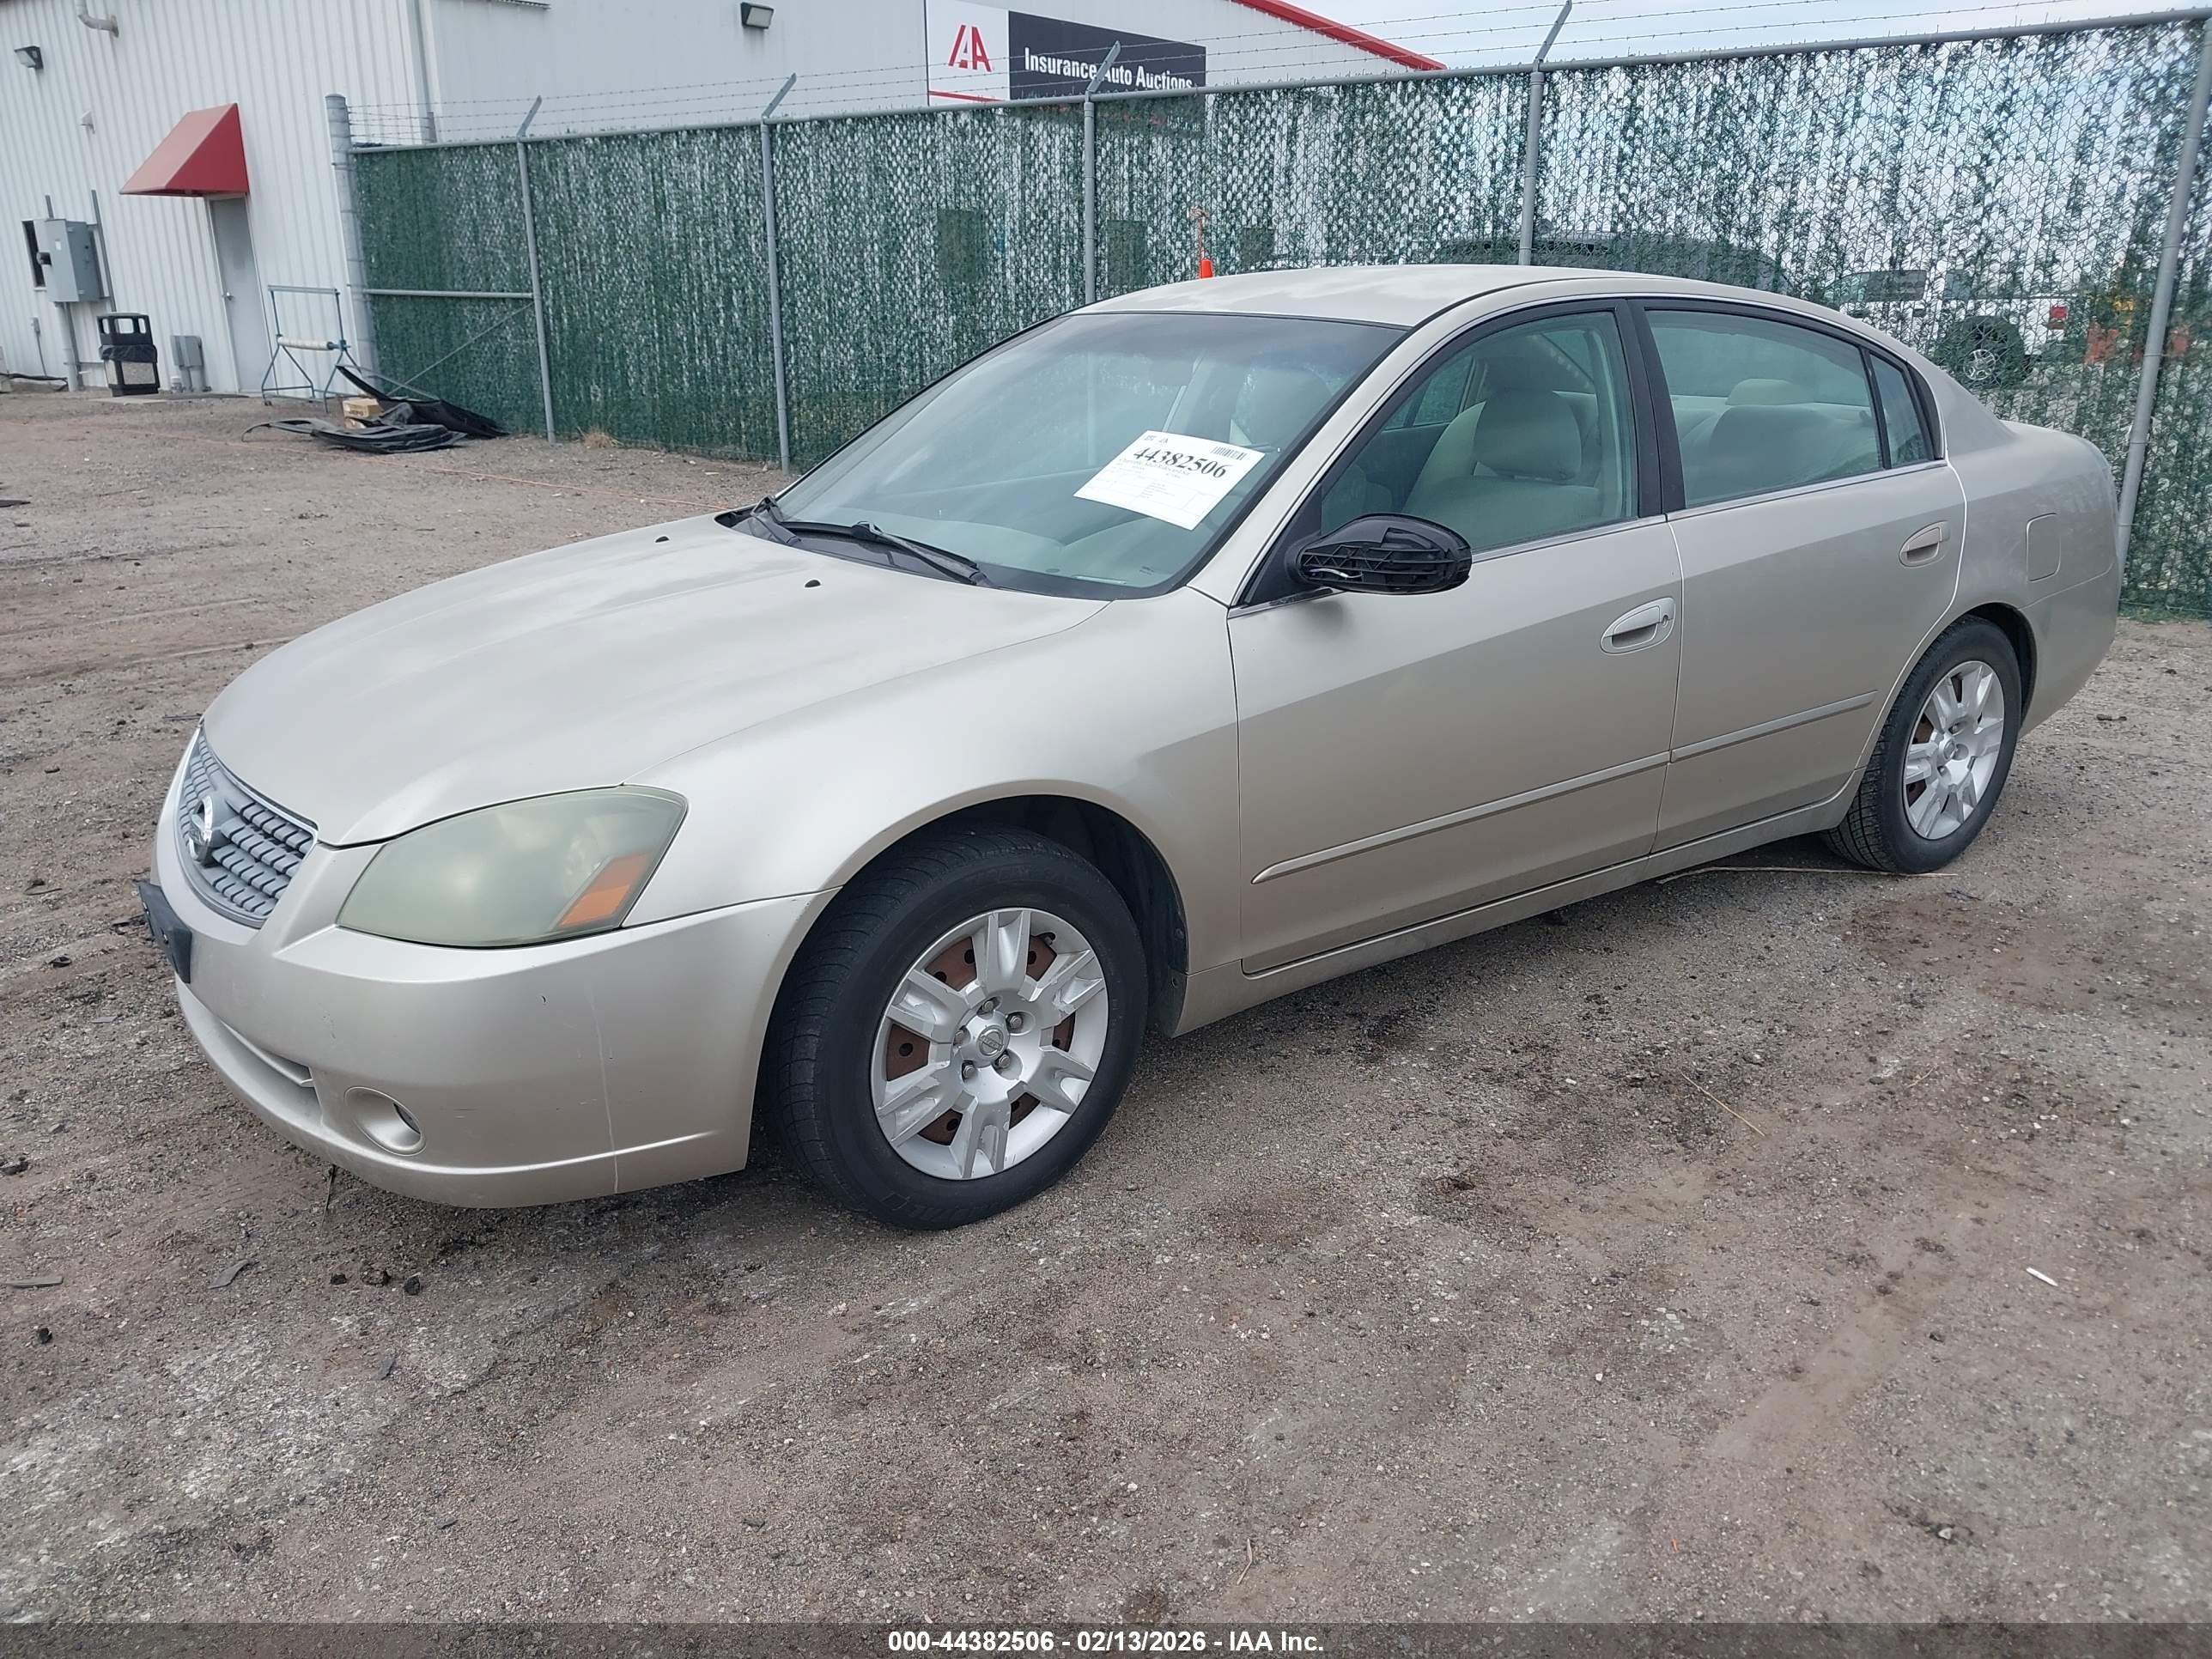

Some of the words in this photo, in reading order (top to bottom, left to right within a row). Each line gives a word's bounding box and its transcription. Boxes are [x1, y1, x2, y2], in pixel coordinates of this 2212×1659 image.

[1024, 46, 1097, 80] Insurance
[1135, 65, 1193, 90] Auctions
[1133, 447, 1232, 478] 44382506
